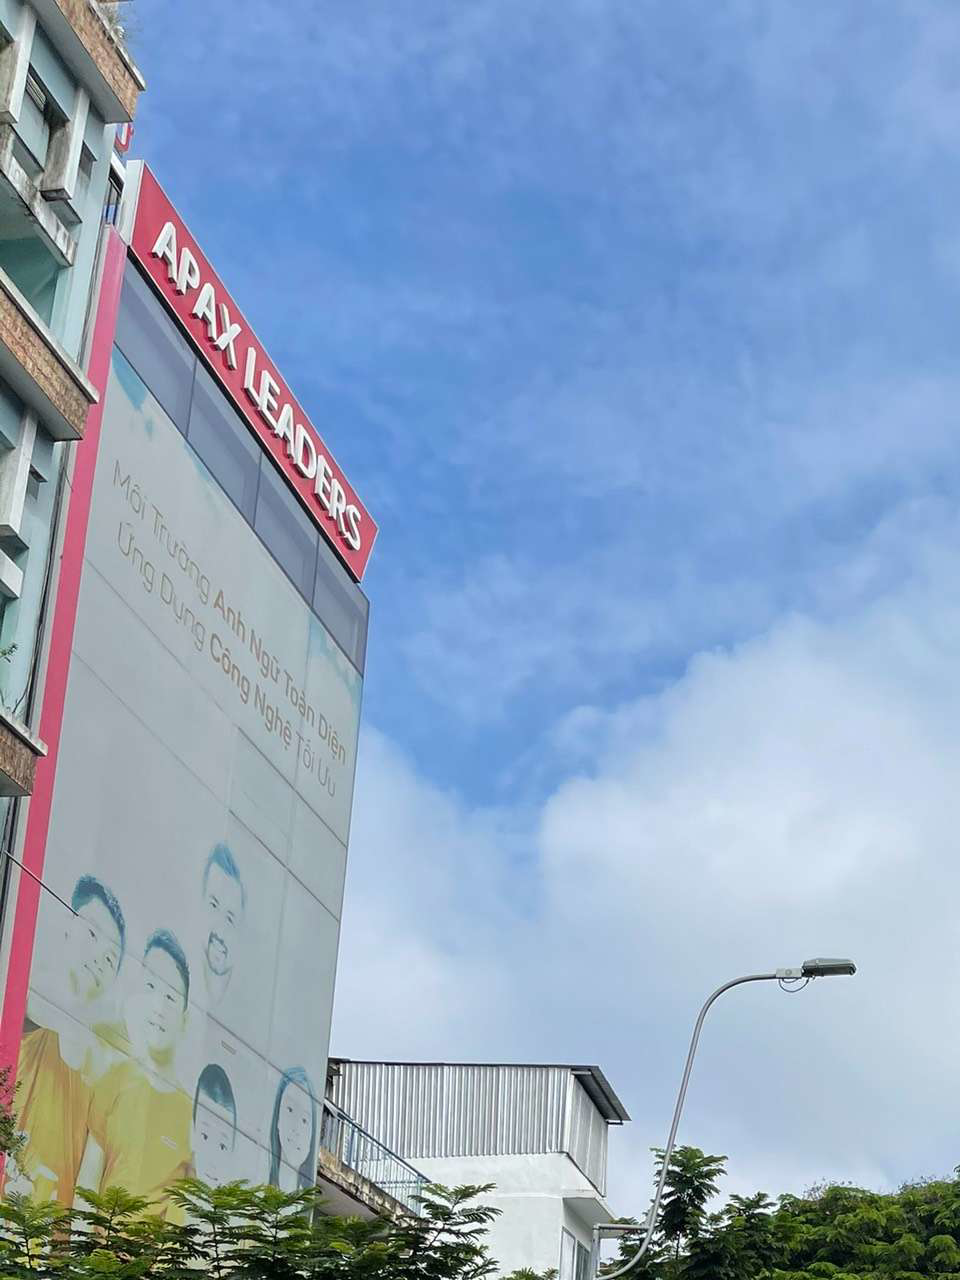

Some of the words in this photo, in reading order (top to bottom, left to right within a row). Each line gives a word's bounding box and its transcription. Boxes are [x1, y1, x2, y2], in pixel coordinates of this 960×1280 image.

[152, 221, 241, 370] APAX
[243, 347, 362, 552] LEADERS
[113, 460, 146, 521] Môi
[152, 502, 210, 606] Trường
[213, 588, 246, 644] Anh
[318, 713, 346, 765] Diện
[118, 520, 155, 593] Ứng
[210, 632, 250, 705] Công
[254, 684, 293, 751] Nghệ
